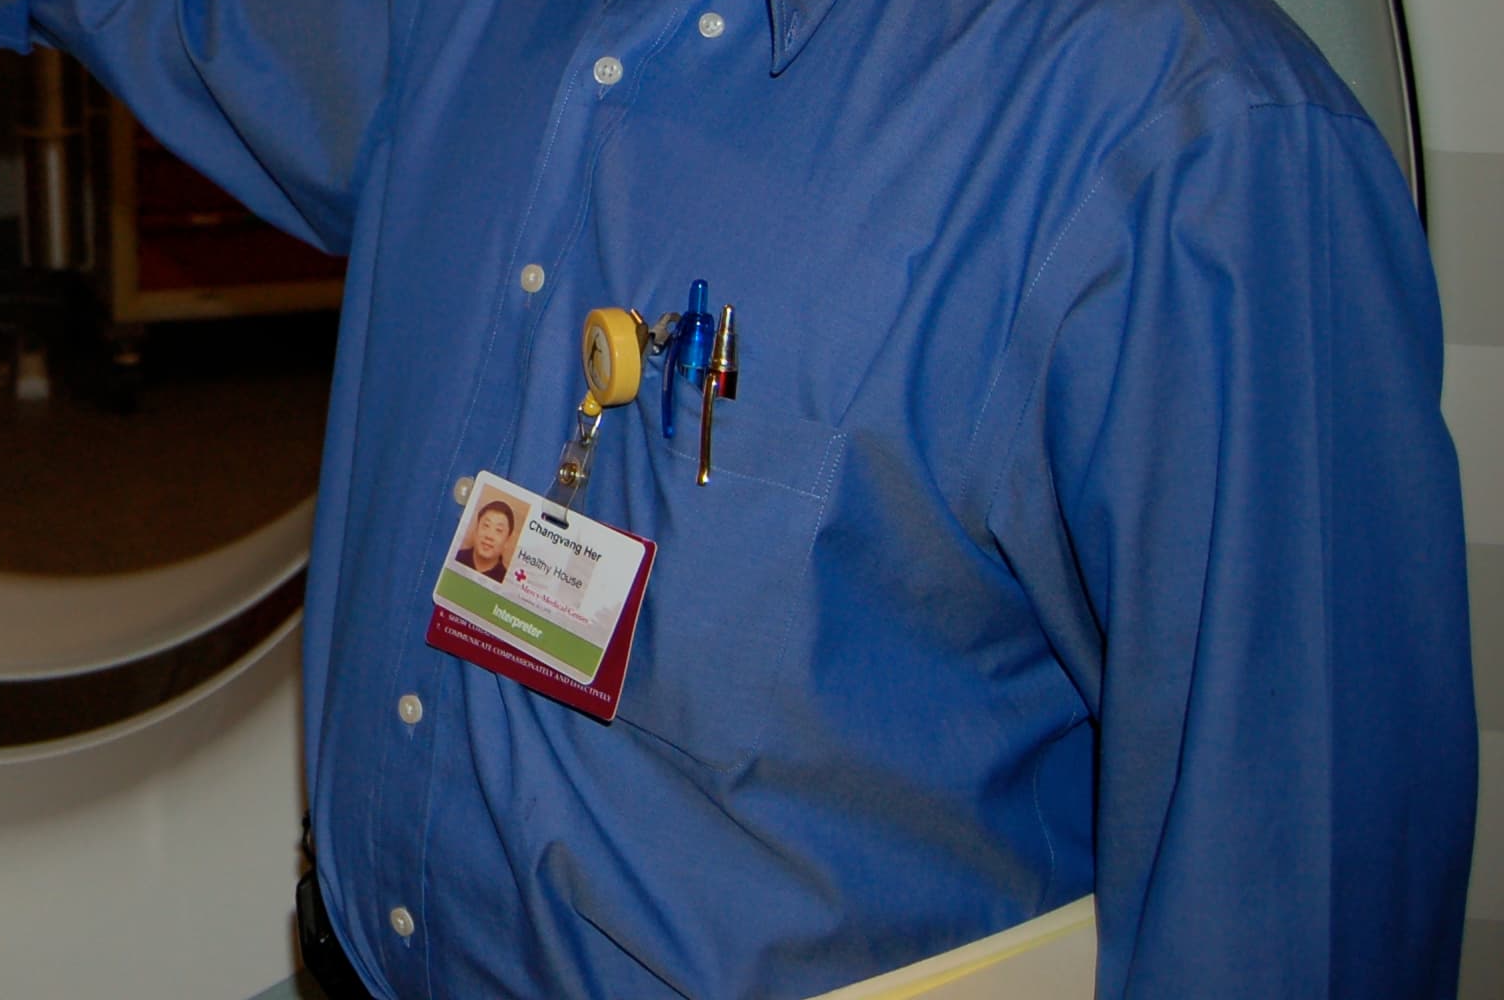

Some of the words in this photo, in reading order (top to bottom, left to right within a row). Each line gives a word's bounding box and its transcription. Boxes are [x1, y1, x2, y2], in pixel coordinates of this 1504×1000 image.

[528, 520, 583, 555] Changvang
[583, 545, 602, 562] Her
[518, 549, 553, 575] Healthy
[553, 567, 583, 589] House
[492, 604, 544, 639] Interpreter
[444, 626, 493, 653] COMMUNICATE
[554, 673, 570, 684] AND
